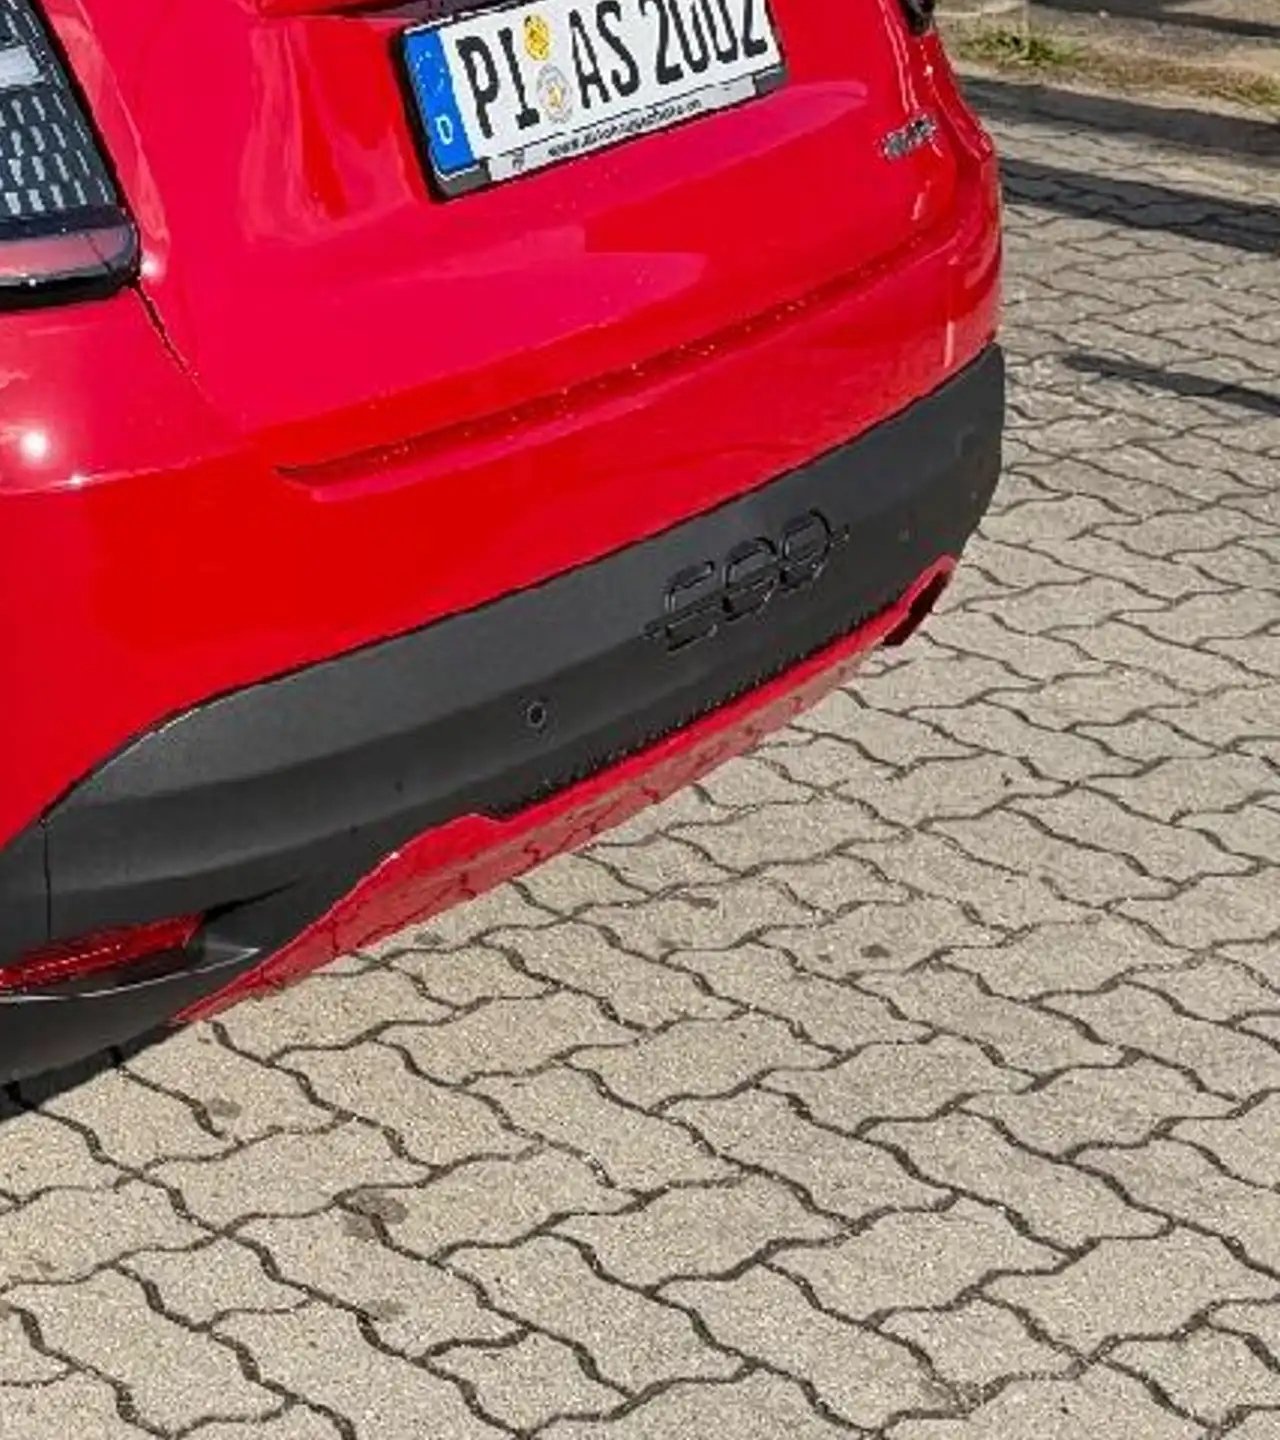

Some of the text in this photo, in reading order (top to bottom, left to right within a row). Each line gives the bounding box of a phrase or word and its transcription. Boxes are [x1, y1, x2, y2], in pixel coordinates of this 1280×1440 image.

[436, 116, 454, 146] D
[455, 25, 541, 139] PI
[567, 0, 642, 111] AS
